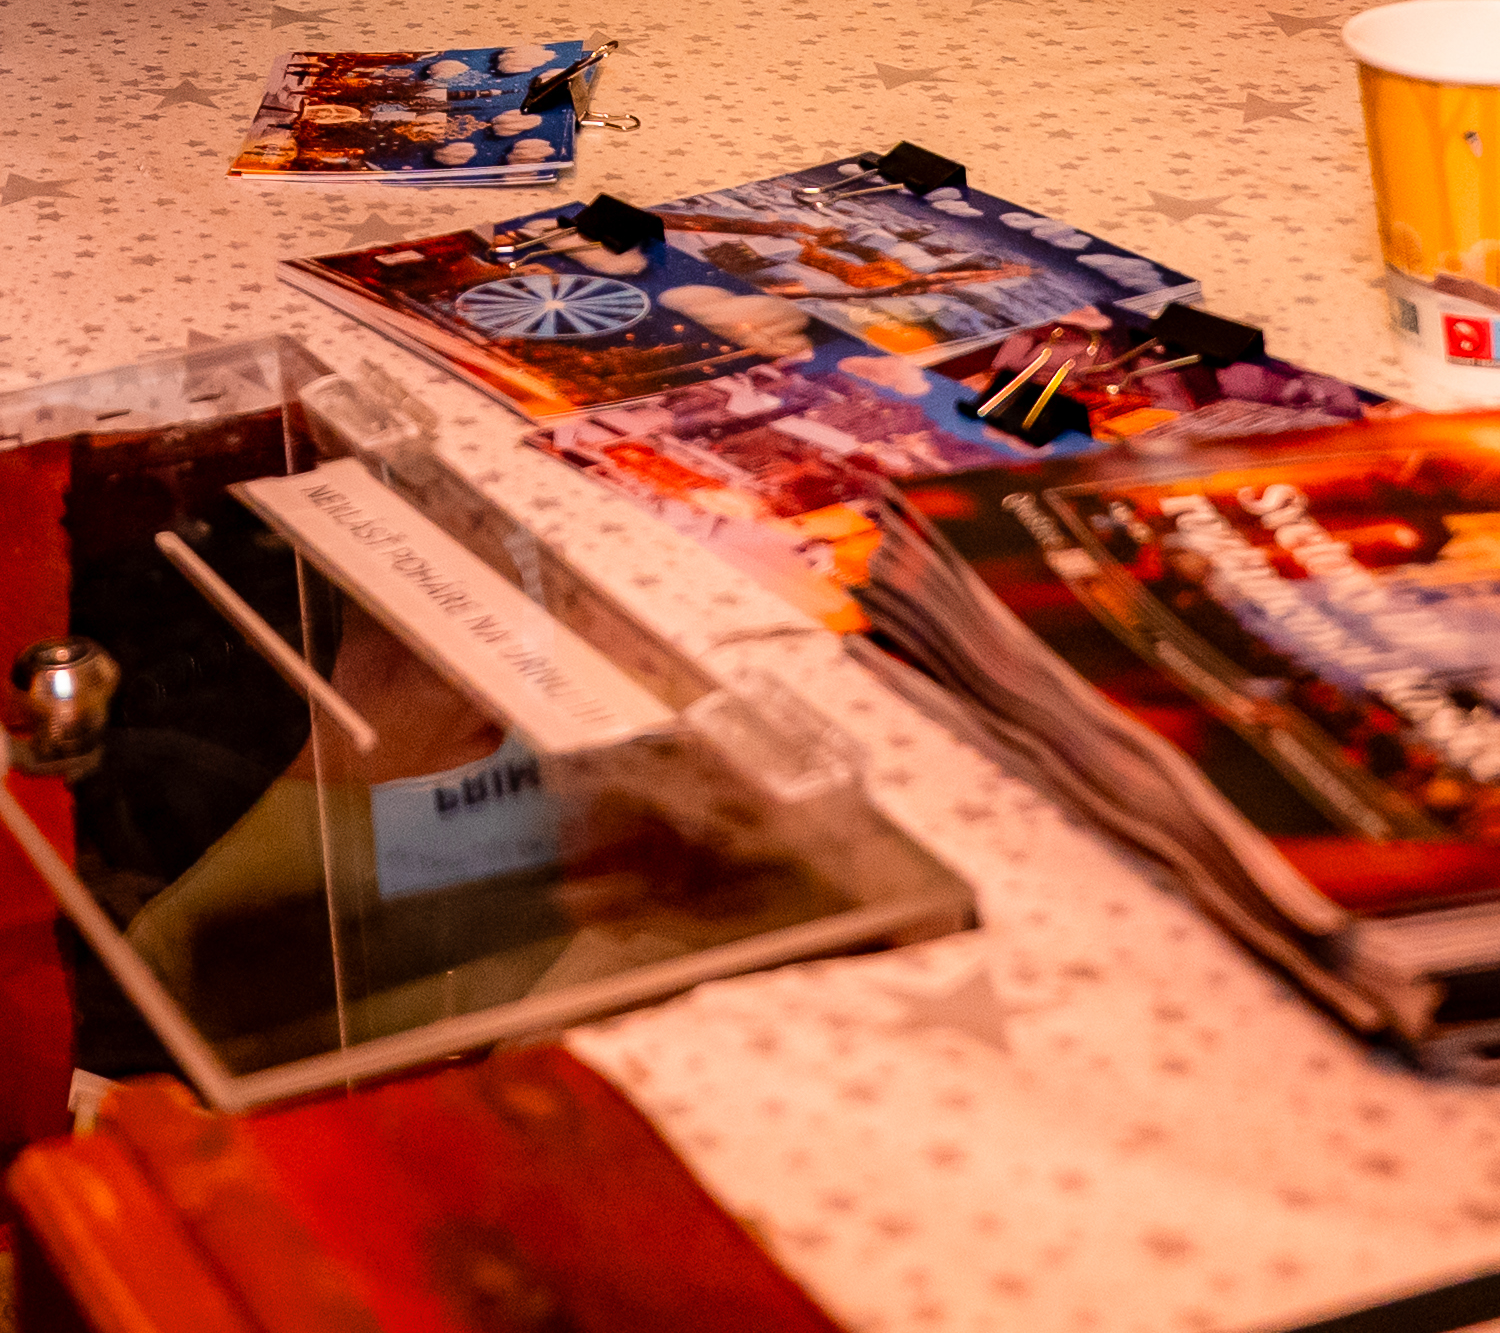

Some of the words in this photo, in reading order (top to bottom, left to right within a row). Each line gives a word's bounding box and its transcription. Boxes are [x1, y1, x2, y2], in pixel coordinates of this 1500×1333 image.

[301, 483, 406, 547] NEKLÁSŤ
[380, 543, 482, 617] POHÁRE
[462, 613, 510, 644] NA
